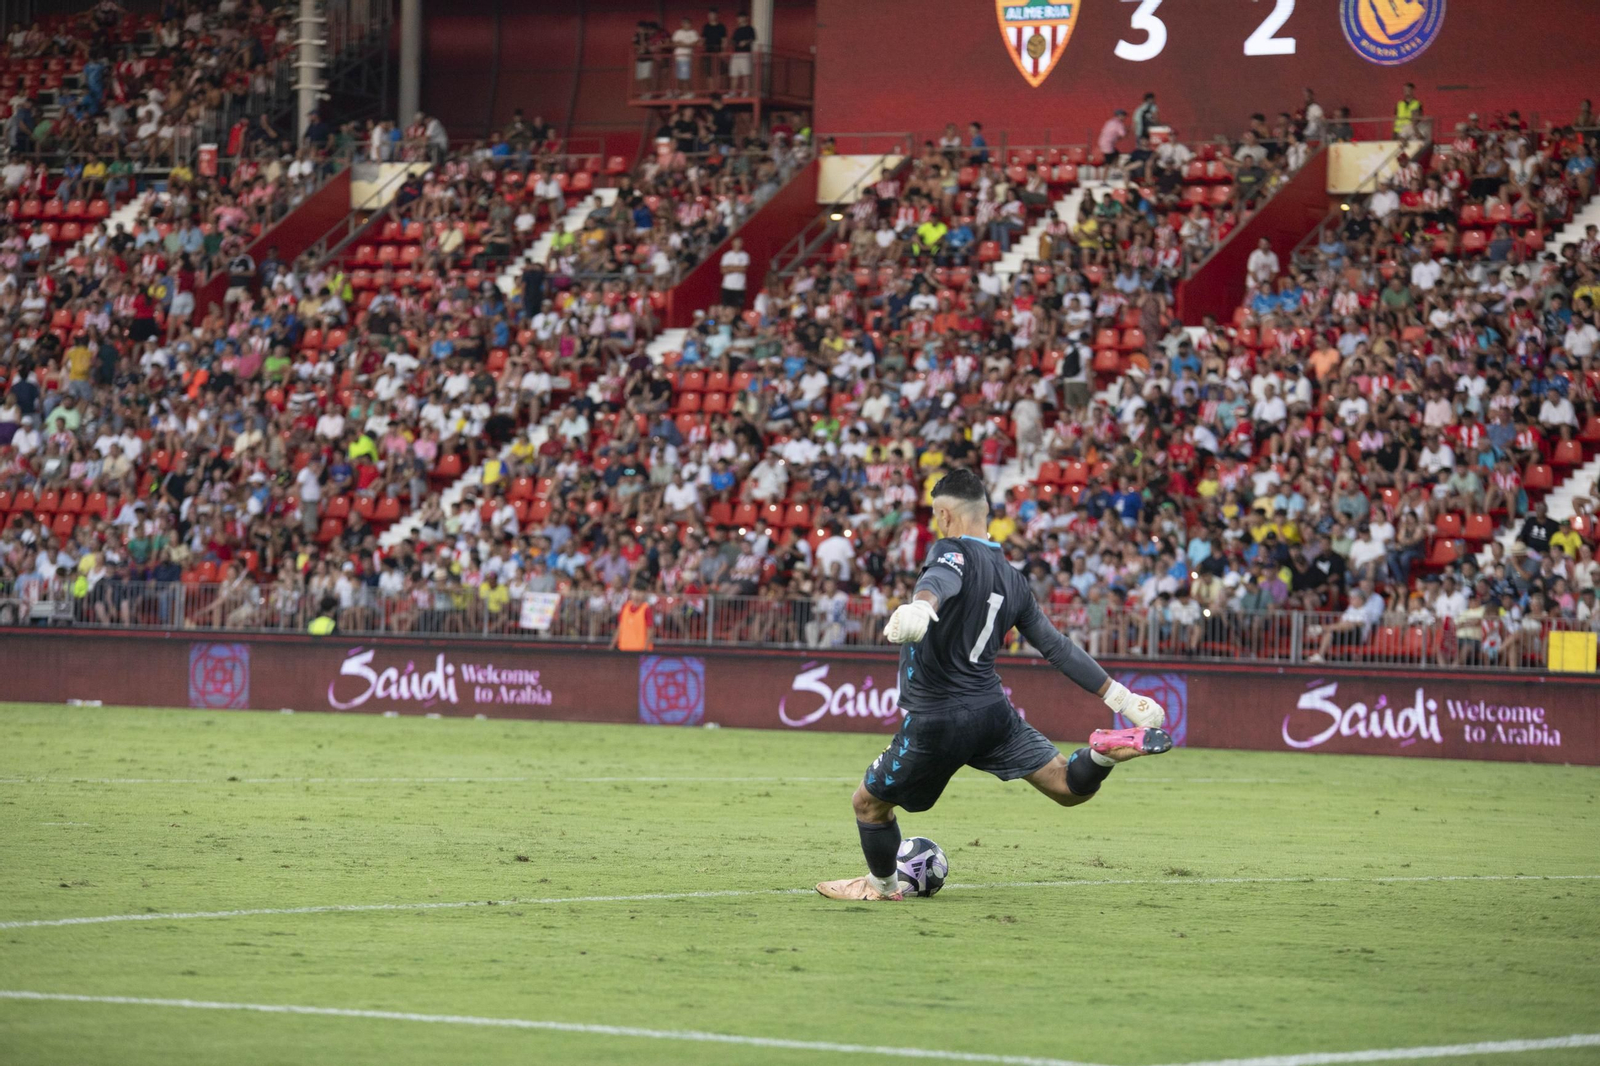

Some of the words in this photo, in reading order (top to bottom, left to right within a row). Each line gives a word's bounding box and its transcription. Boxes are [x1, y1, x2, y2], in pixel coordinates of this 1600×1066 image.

[1114, 0, 1167, 62] 3
[1243, 0, 1296, 56] 2
[968, 592, 1005, 664] 1
[461, 663, 541, 685] Welcome
[474, 684, 494, 703] to
[495, 684, 553, 705] Arabia
[779, 661, 908, 727] Saud
[1446, 699, 1545, 723] Welcome
[1464, 724, 1487, 743] to
[1491, 723, 1561, 746] Arabia
